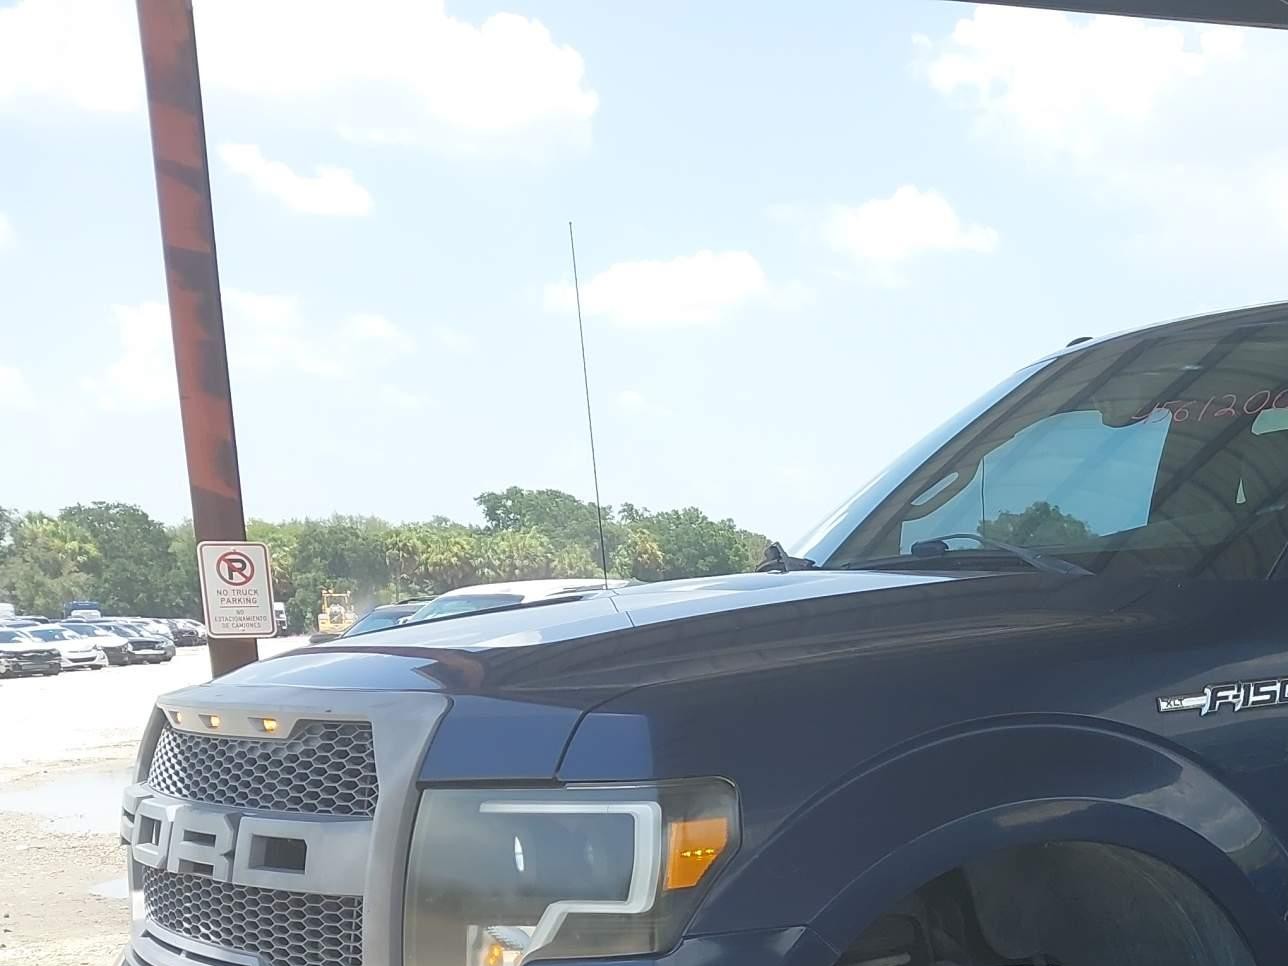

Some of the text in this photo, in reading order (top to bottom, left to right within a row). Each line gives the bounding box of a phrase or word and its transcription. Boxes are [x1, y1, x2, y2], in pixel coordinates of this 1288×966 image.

[217, 588, 259, 597] NO TRUCK
[220, 597, 258, 605] PARKING
